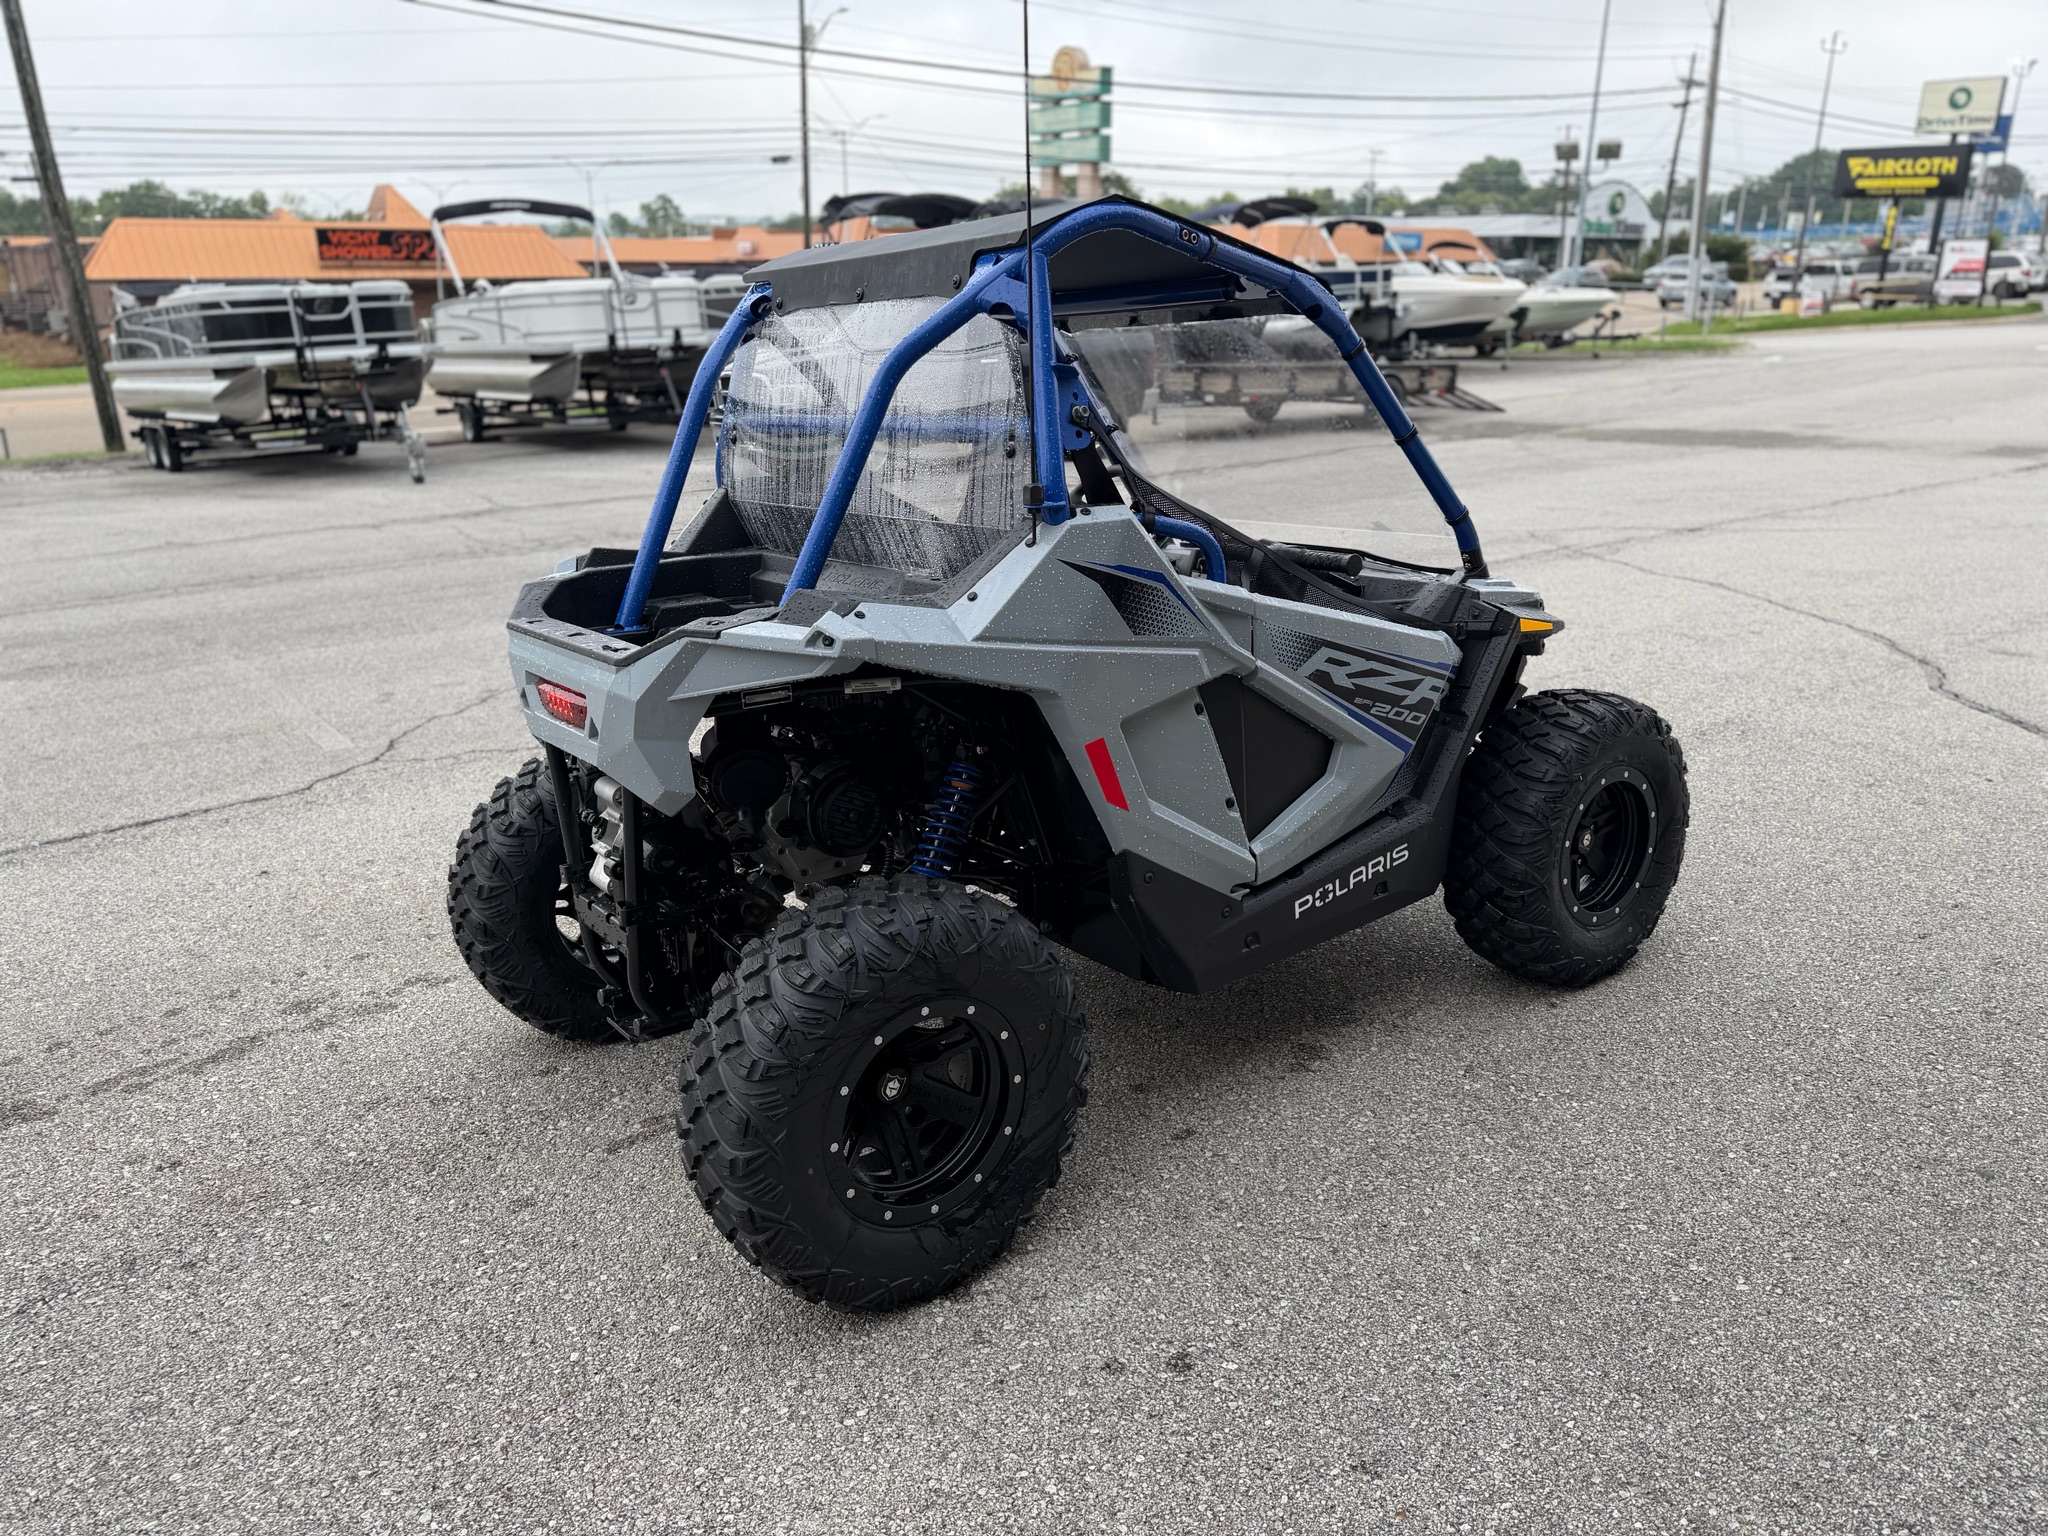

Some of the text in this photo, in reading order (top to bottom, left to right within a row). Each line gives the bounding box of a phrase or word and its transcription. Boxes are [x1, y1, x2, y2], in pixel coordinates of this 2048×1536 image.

[1847, 155, 1959, 179] FAIRCLOTH
[1370, 702, 1427, 725] 200
[1294, 842, 1410, 920] POLARIS
